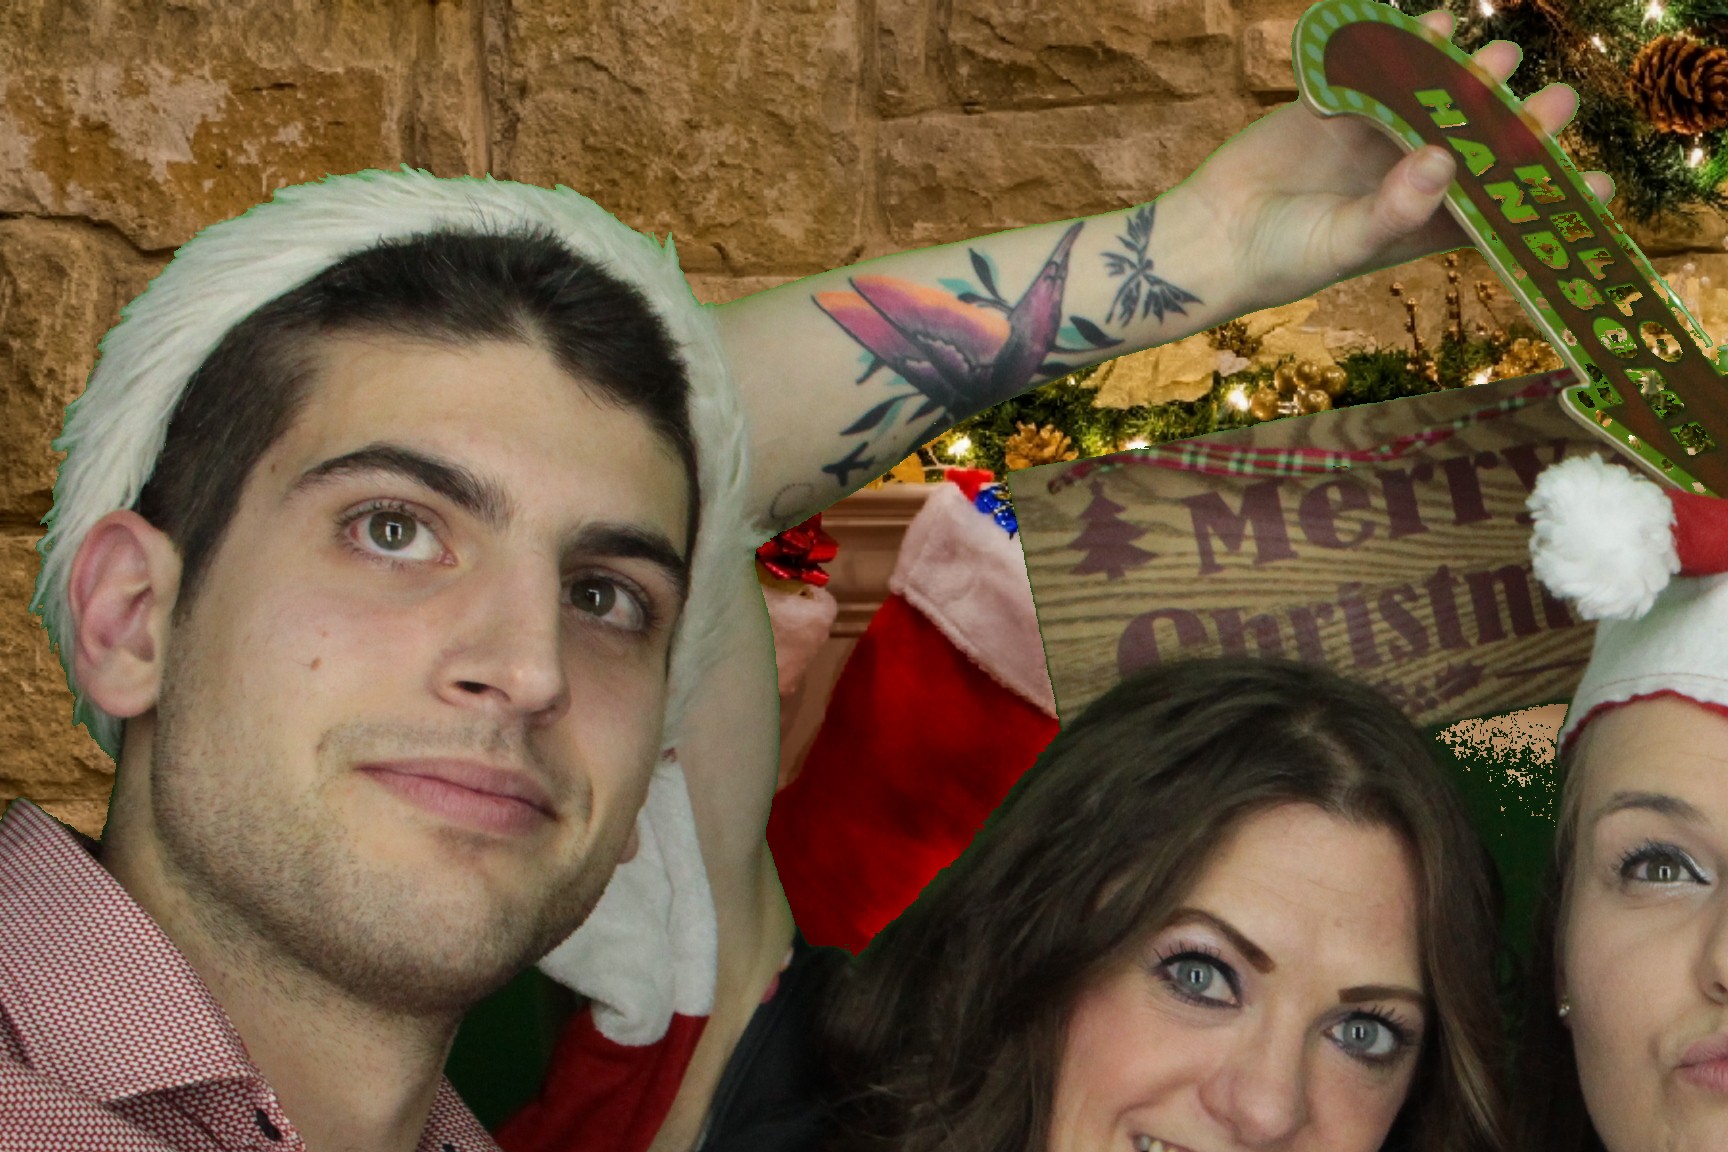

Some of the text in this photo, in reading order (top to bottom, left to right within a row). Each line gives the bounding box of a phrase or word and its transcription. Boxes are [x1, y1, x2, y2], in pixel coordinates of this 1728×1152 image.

[1413, 88, 1716, 457] HANDSOME
[1513, 163, 1683, 363] HELLO
[1117, 563, 1577, 680] Christm
